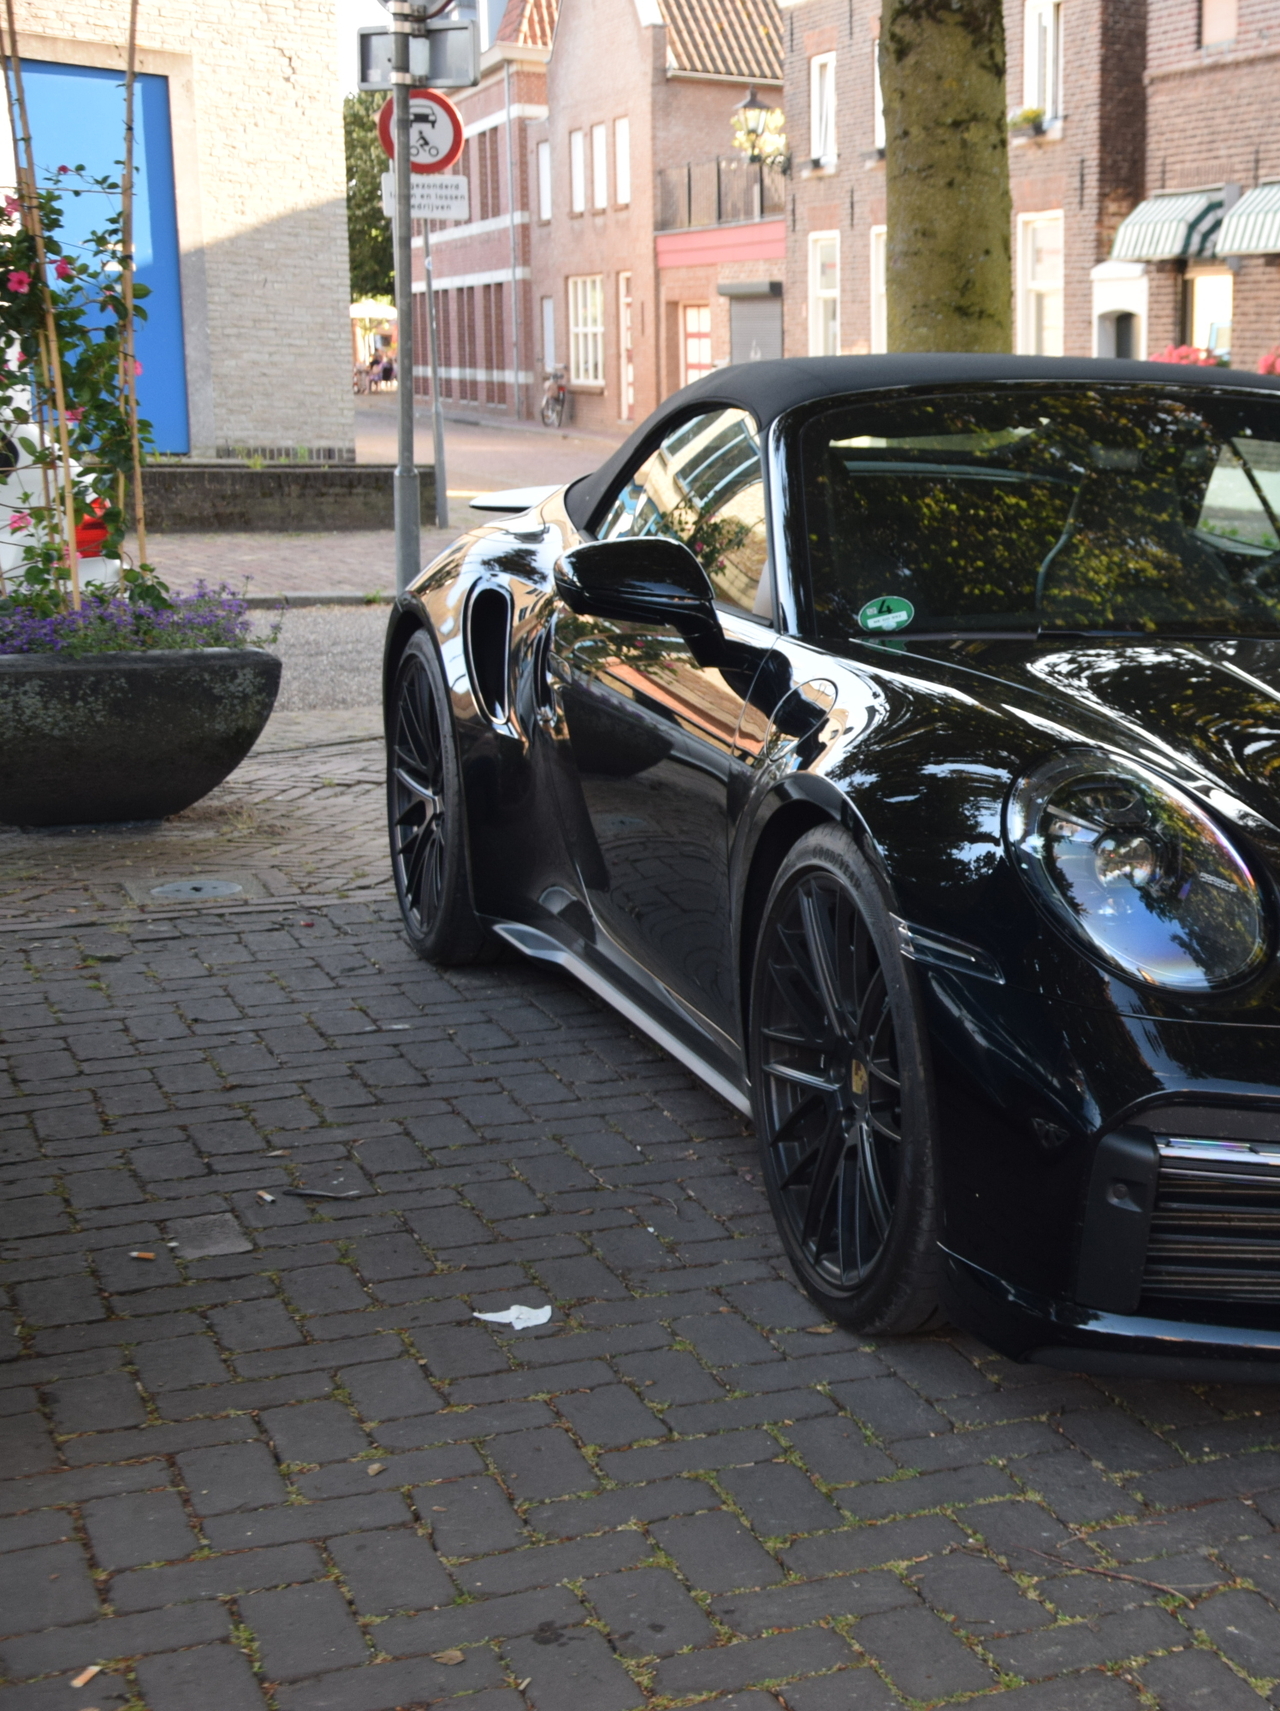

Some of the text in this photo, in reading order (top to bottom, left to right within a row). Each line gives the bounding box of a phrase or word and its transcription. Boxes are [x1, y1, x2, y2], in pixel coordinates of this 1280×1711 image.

[410, 182, 460, 191] gezonderd
[410, 203, 452, 212] edrijven
[877, 599, 893, 614] 4
[813, 844, 862, 891] GOODYEAR
